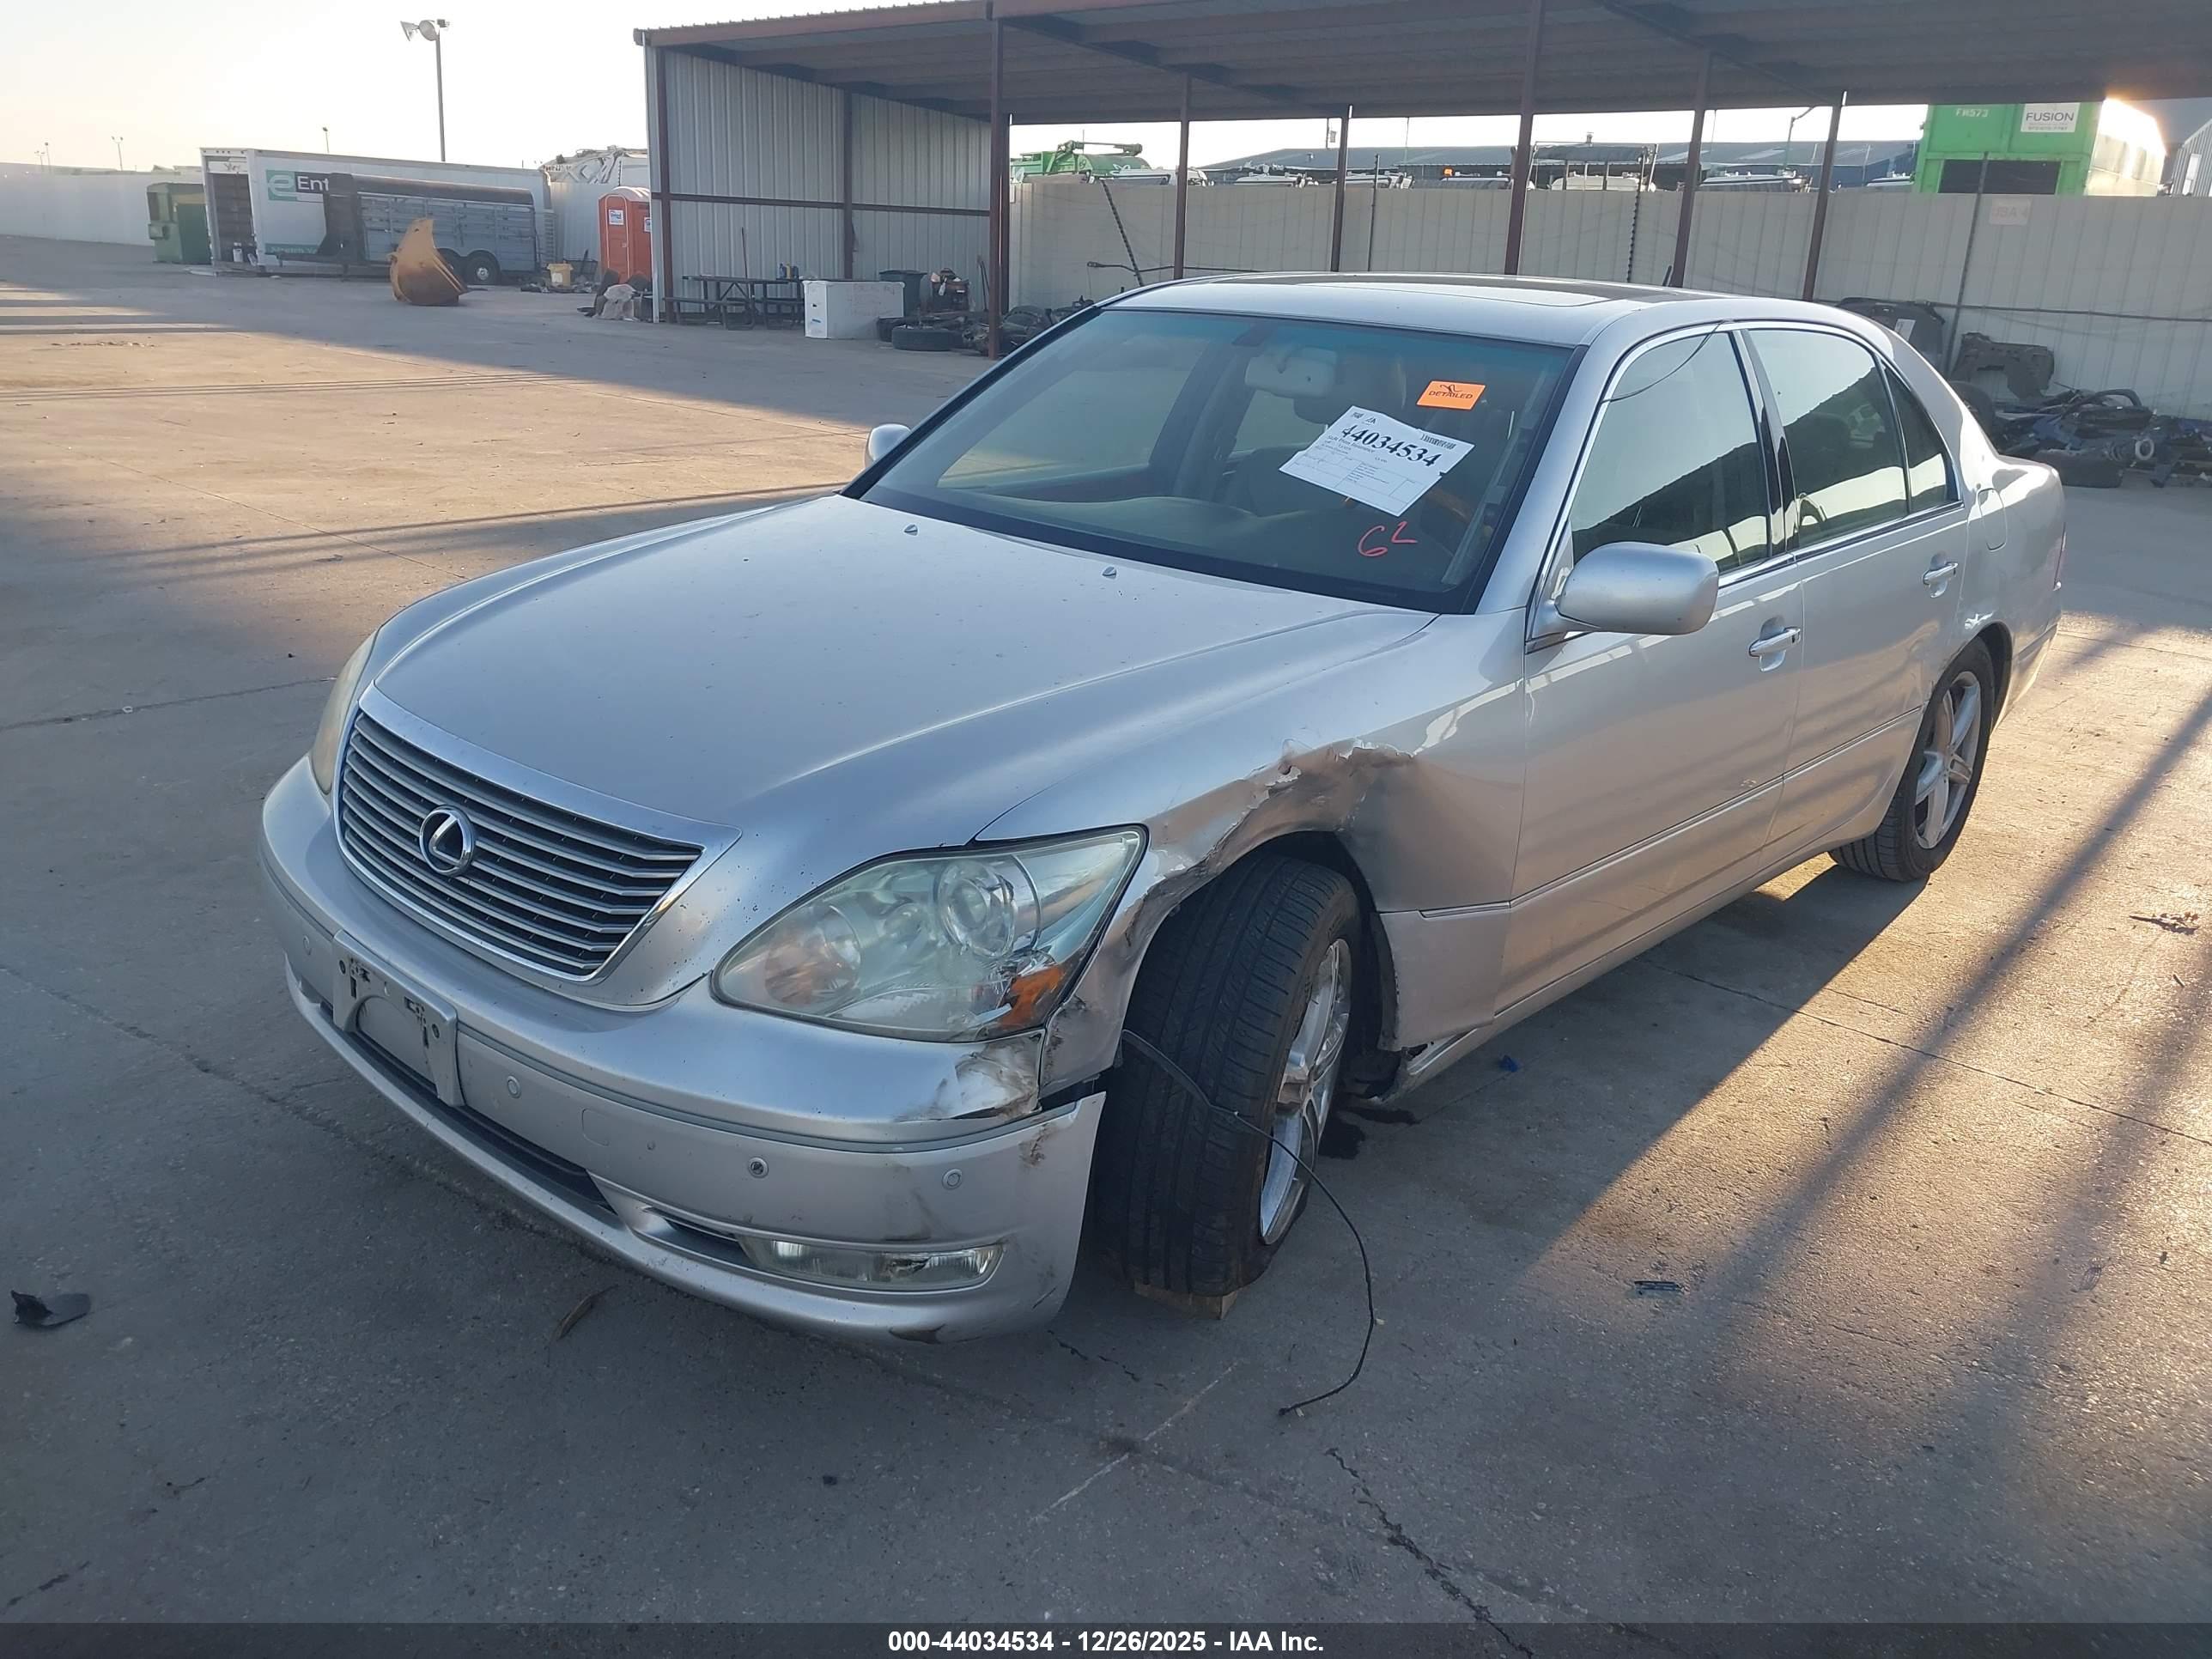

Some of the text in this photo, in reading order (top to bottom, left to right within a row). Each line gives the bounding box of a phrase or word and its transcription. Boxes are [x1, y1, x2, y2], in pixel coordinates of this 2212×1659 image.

[2026, 112, 2075, 122] FUSION
[1428, 390, 1474, 399] DETAILED
[1341, 424, 1443, 467] 44034534
